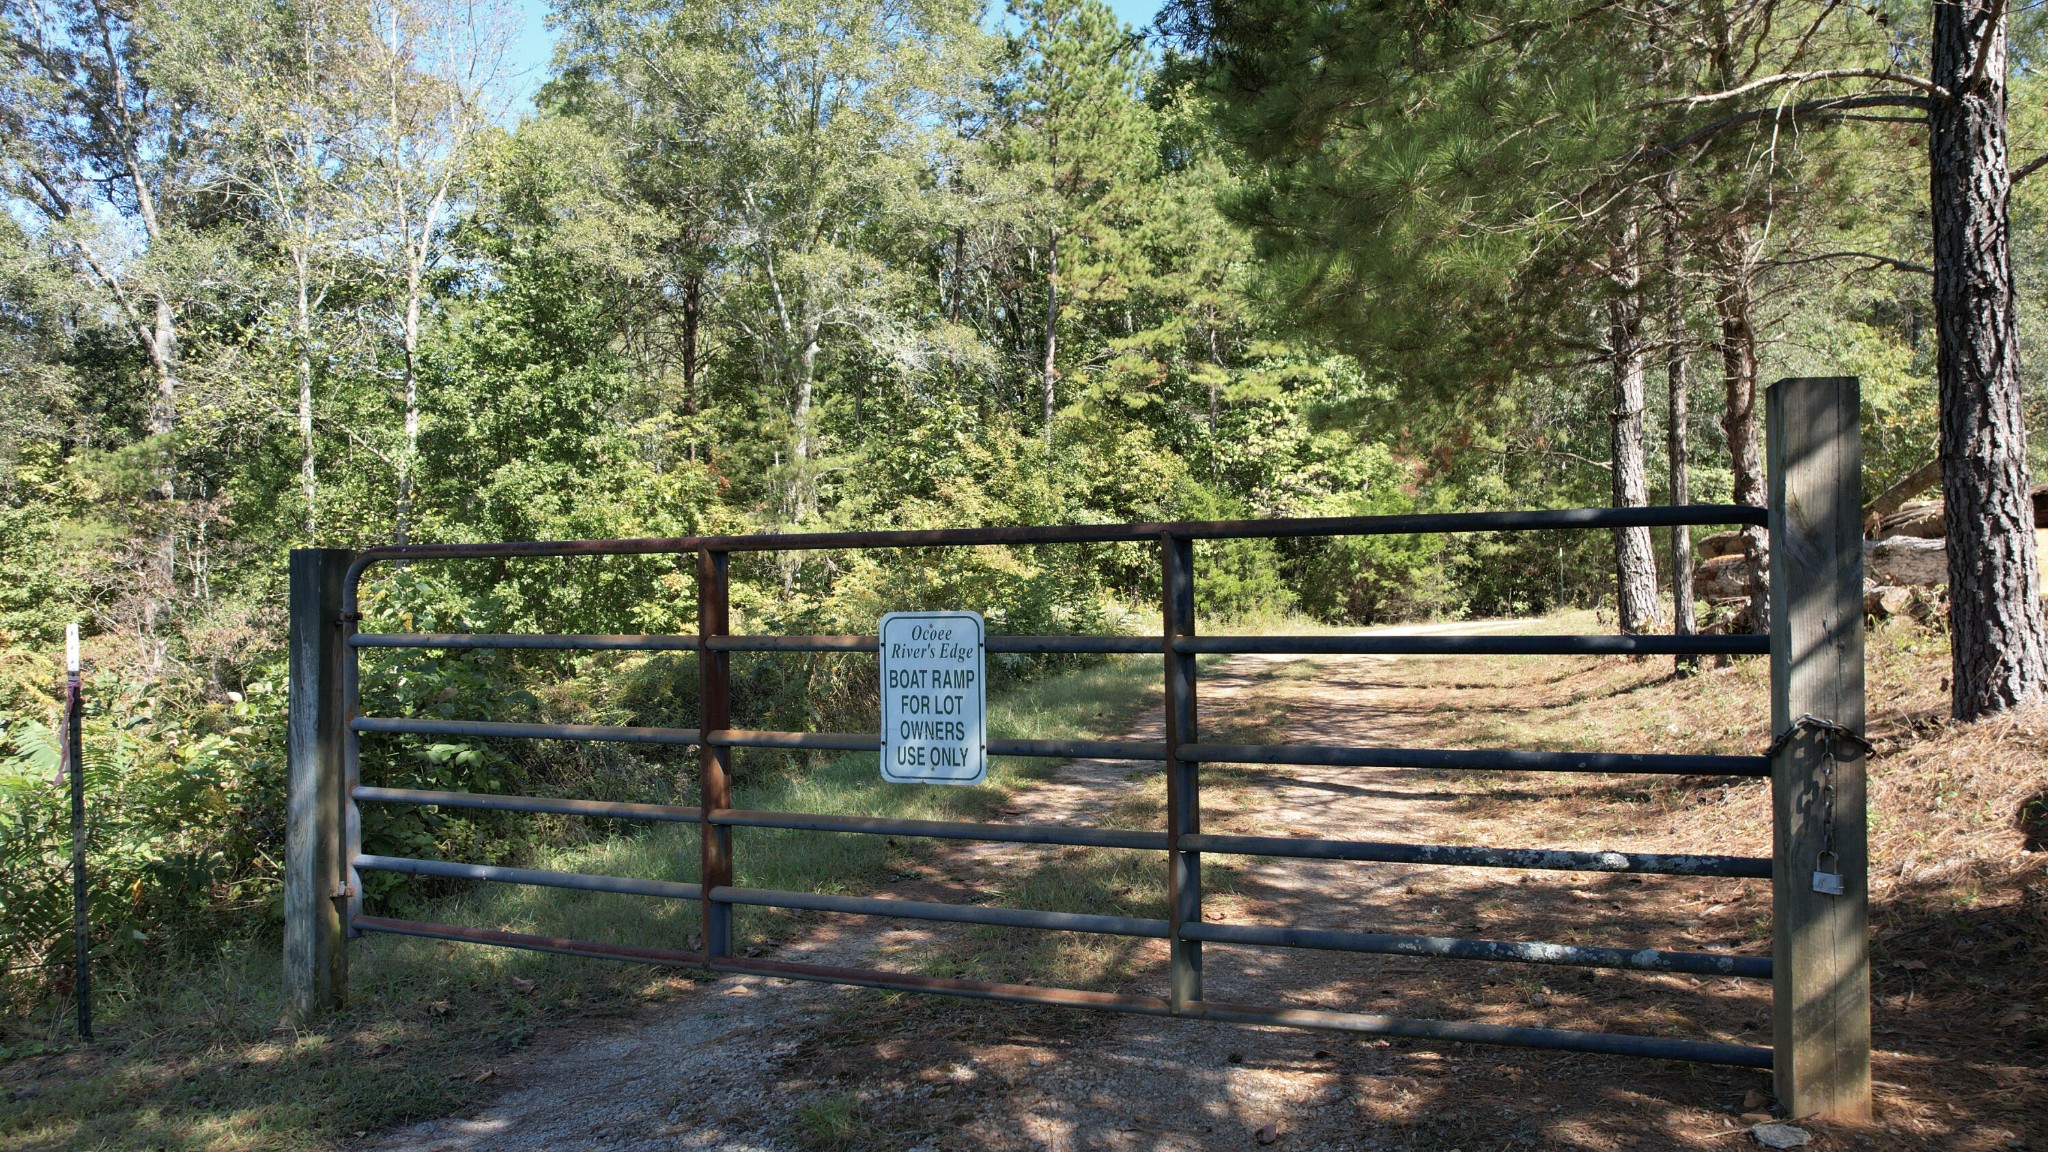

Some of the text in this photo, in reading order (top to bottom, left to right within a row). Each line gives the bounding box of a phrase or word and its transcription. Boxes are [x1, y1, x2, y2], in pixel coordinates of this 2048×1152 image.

[911, 625, 952, 641] Ocoee
[891, 643, 973, 663] River's Edge
[889, 669, 975, 689] BOAT RAMP
[901, 695, 963, 715] FOR LOT
[900, 720, 965, 741] OWNERS
[897, 746, 968, 767] USE ONLY
